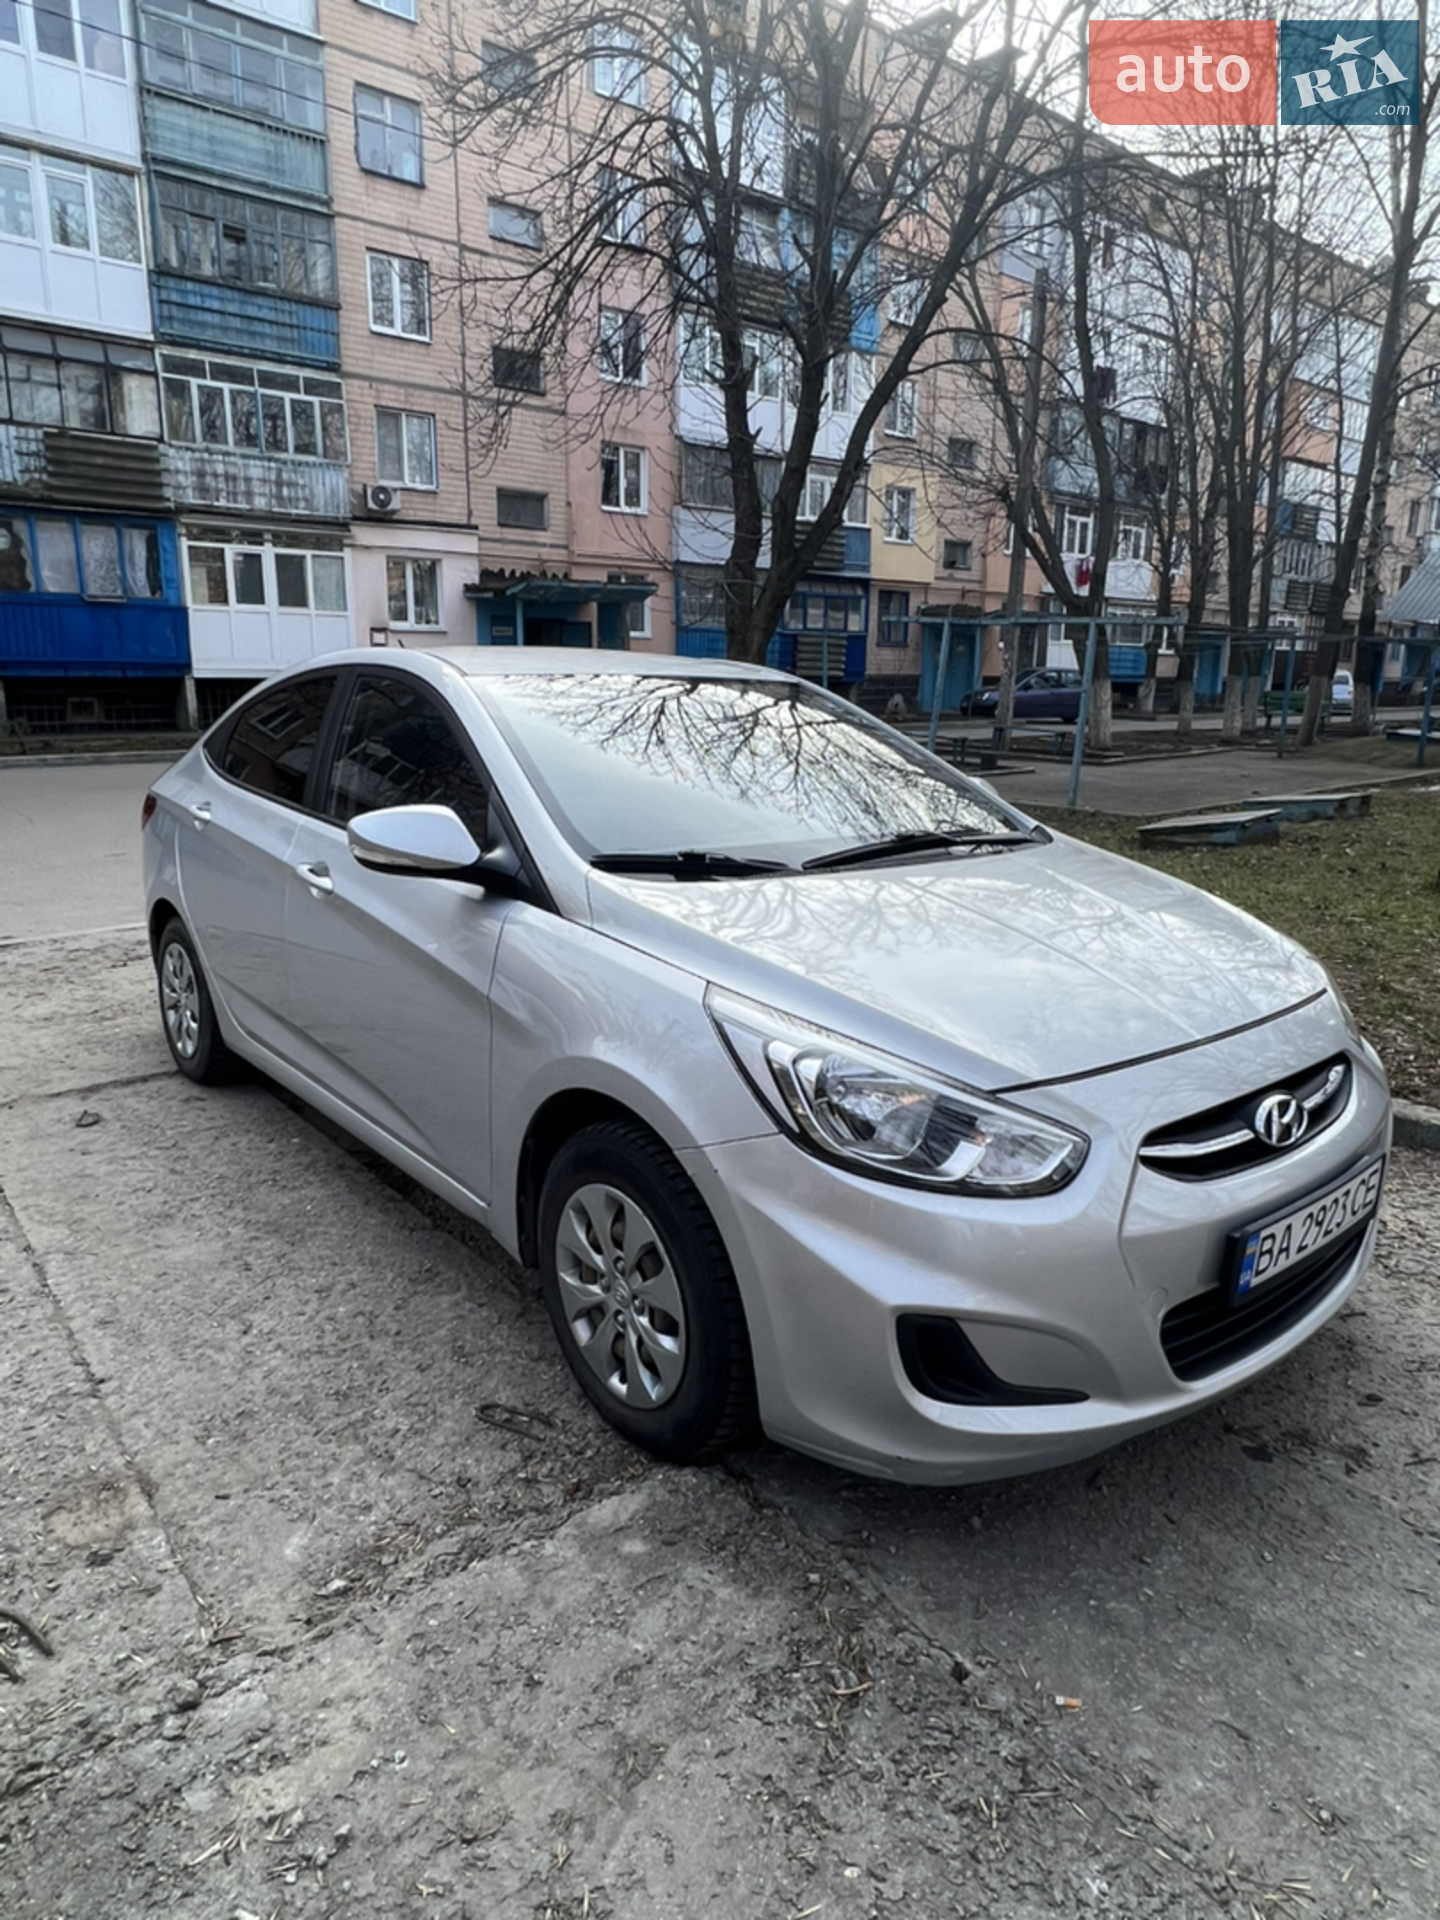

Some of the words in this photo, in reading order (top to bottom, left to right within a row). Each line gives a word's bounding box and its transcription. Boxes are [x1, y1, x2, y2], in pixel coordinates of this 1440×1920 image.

[1254, 1222, 1293, 1278] BA
[1296, 1188, 1351, 1255] 2923
[1350, 1168, 1379, 1217] CE
